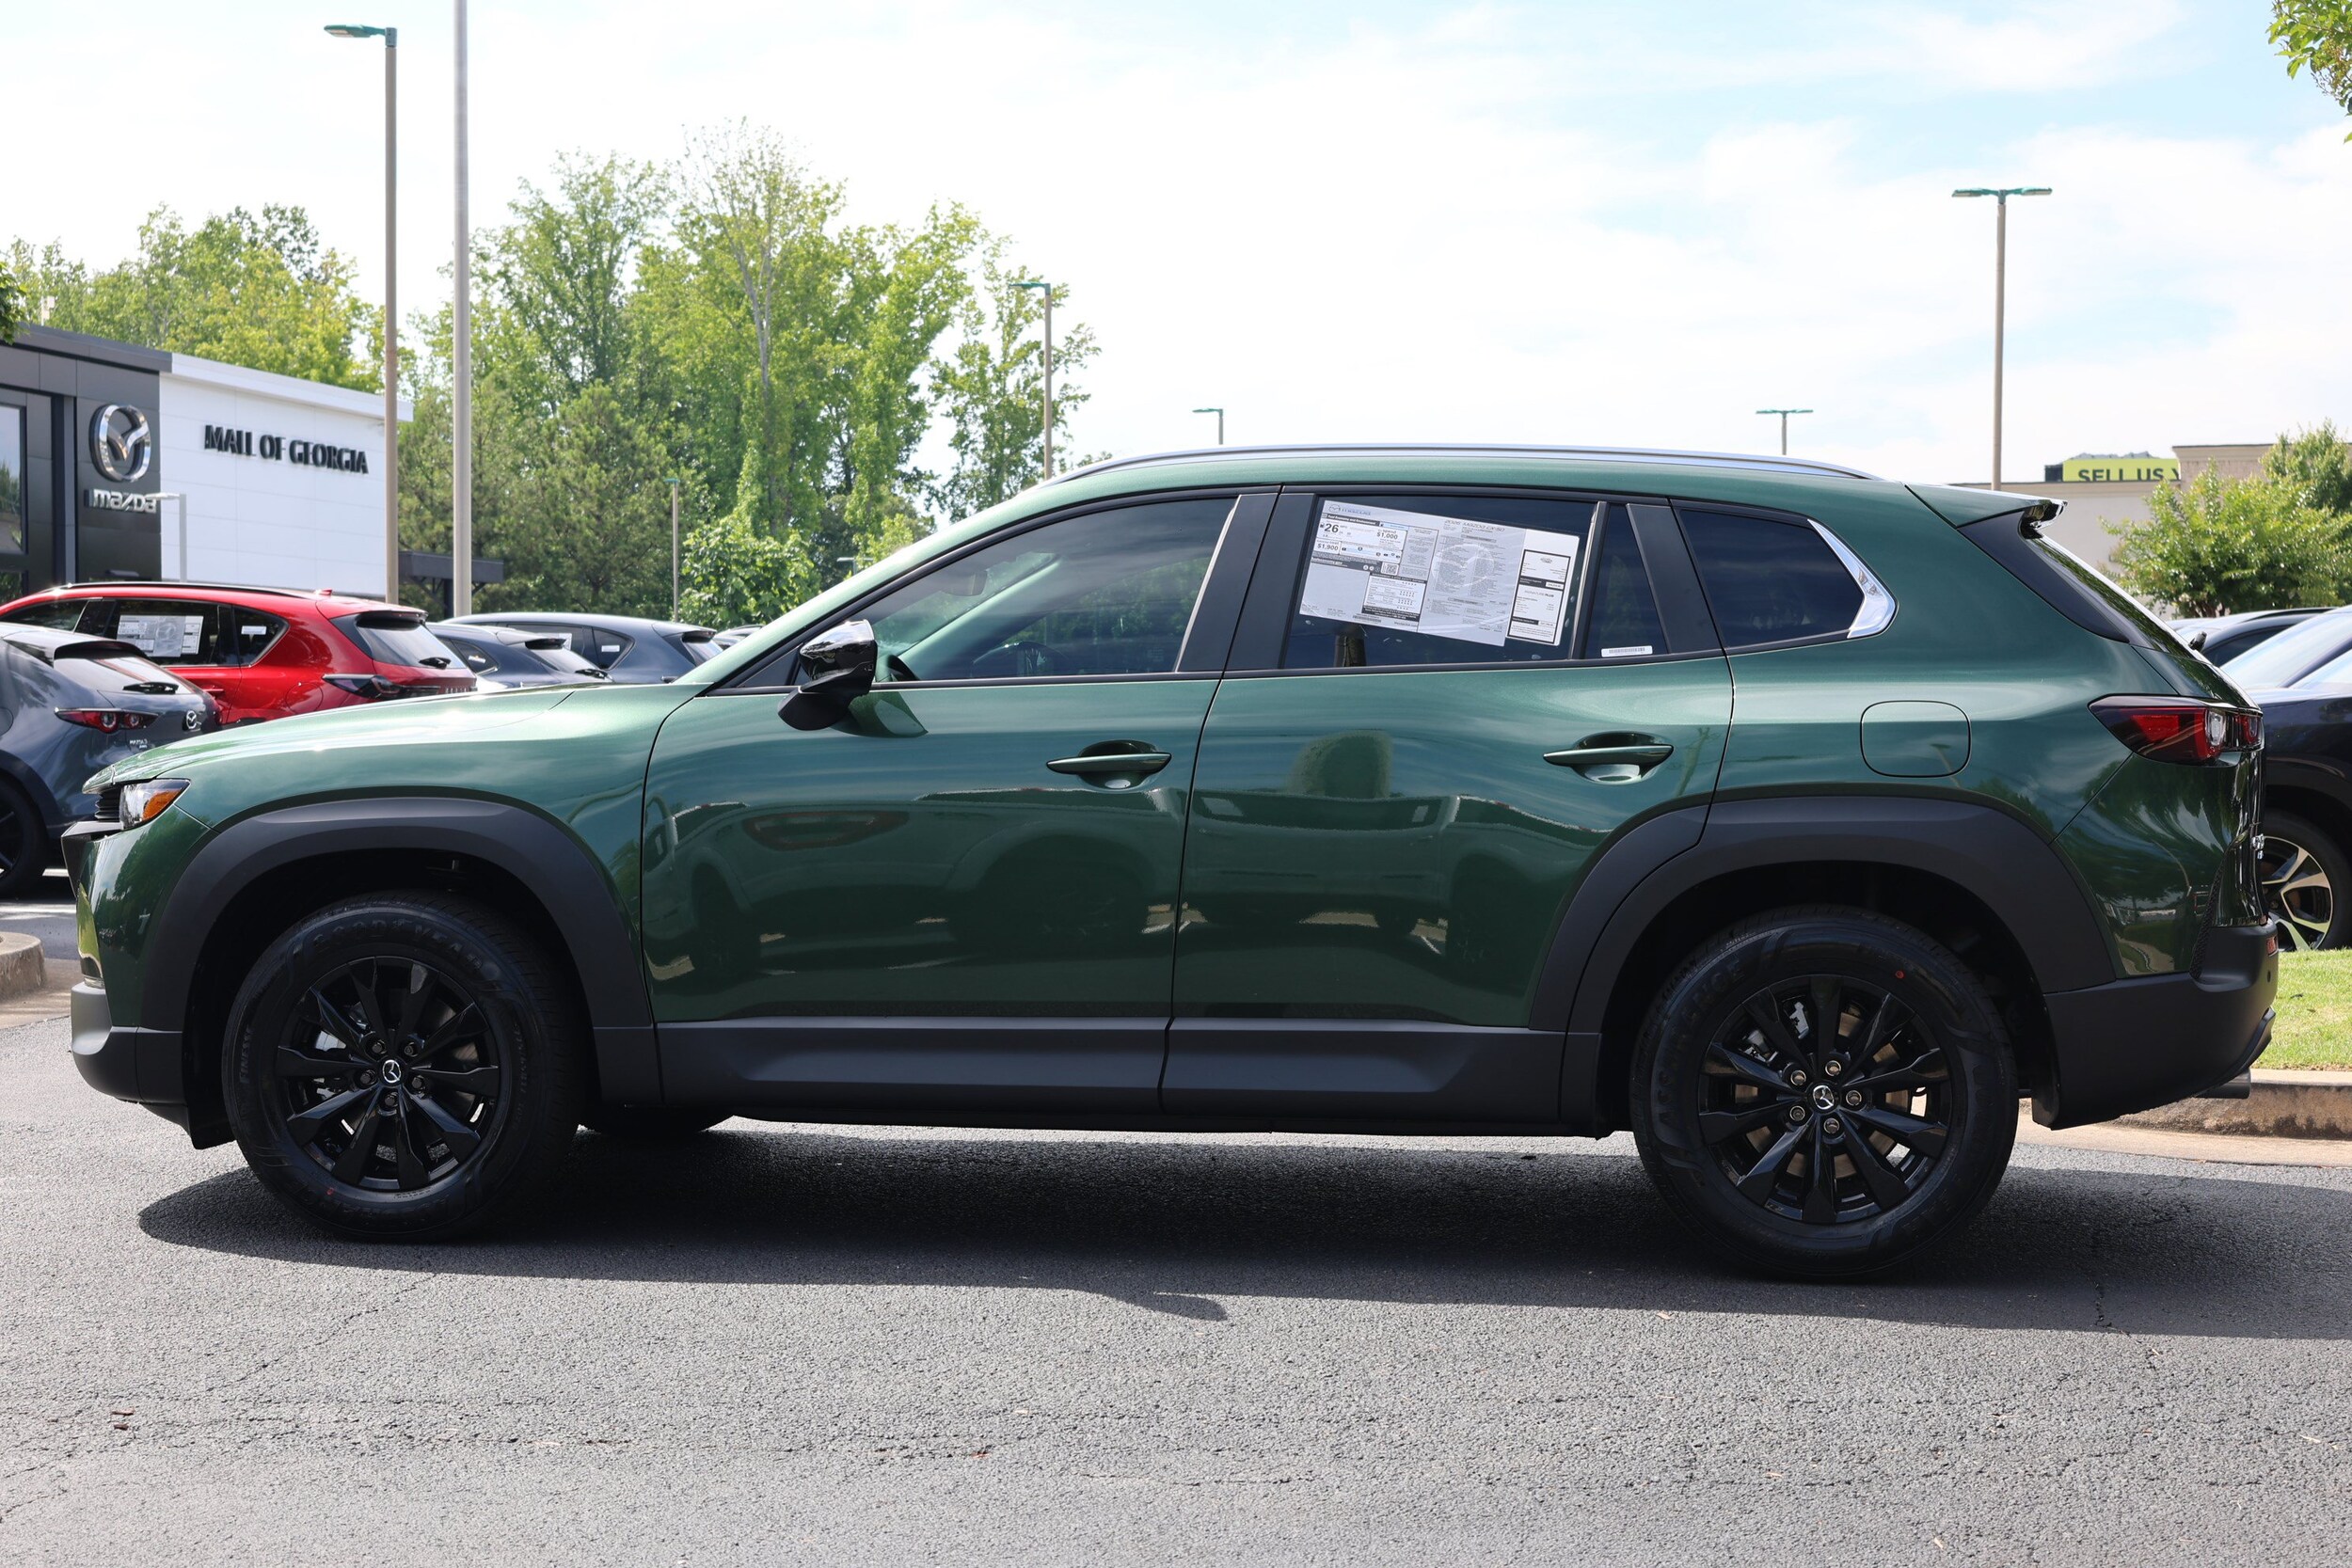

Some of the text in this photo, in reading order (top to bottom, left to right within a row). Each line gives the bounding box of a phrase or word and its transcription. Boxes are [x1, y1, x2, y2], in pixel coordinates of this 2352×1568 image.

[204, 424, 369, 474] MALL OF GEORGIA
[2137, 468, 2164, 481] US
[1324, 523, 1340, 533] 26
[1376, 531, 1399, 540] $1,000
